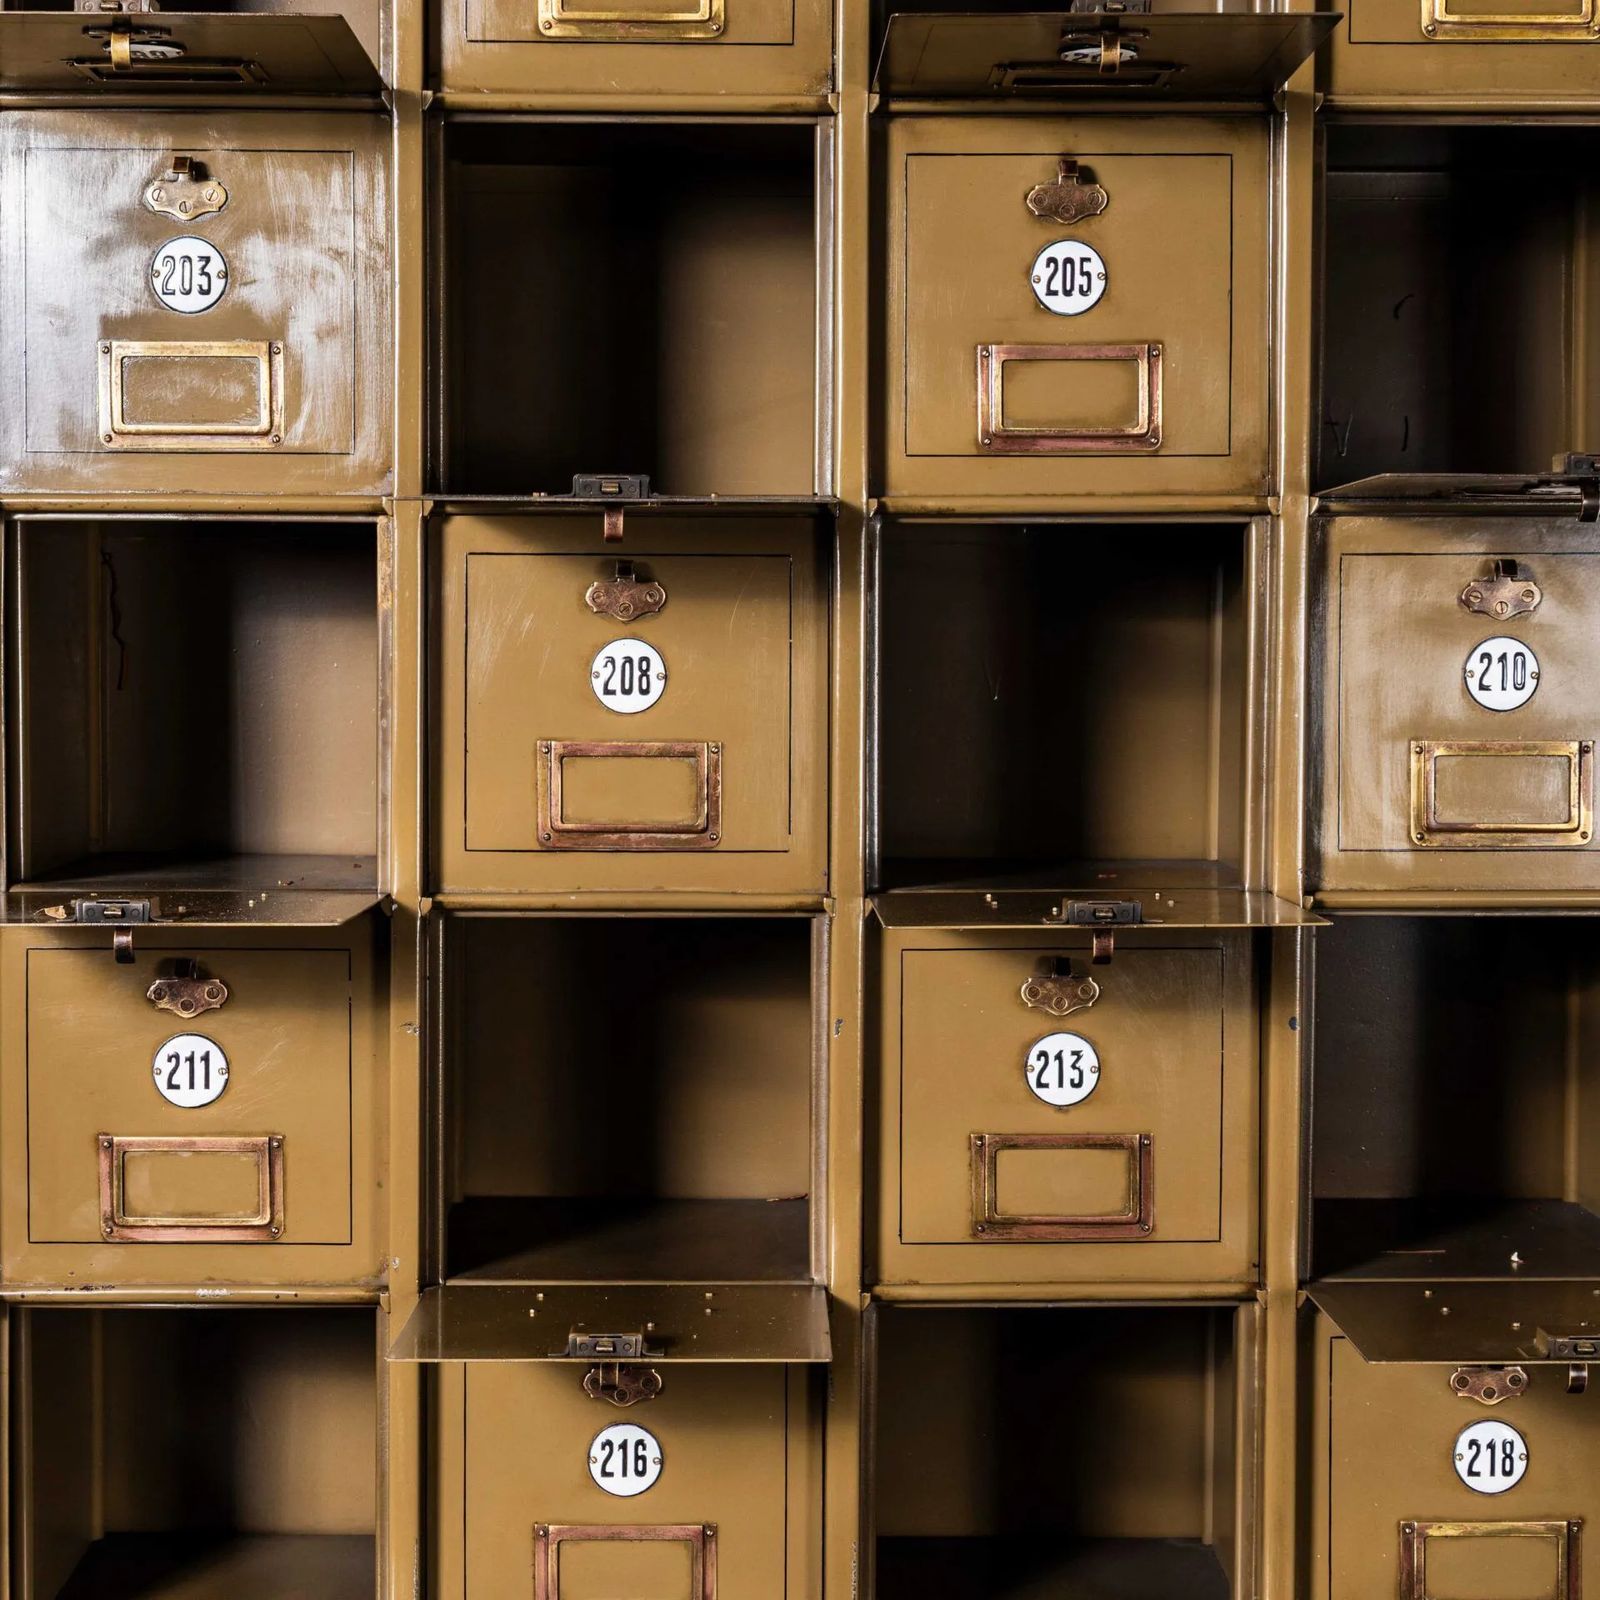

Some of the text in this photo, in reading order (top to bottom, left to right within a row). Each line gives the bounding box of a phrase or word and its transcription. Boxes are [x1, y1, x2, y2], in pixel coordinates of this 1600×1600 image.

[162, 255, 211, 296] 203
[1046, 256, 1092, 296] 205
[604, 656, 650, 696] 208
[1479, 651, 1525, 692] 210
[166, 1050, 210, 1090] 211
[1036, 1049, 1083, 1089] 213
[600, 1438, 647, 1478] 216
[1467, 1437, 1515, 1477] 218
